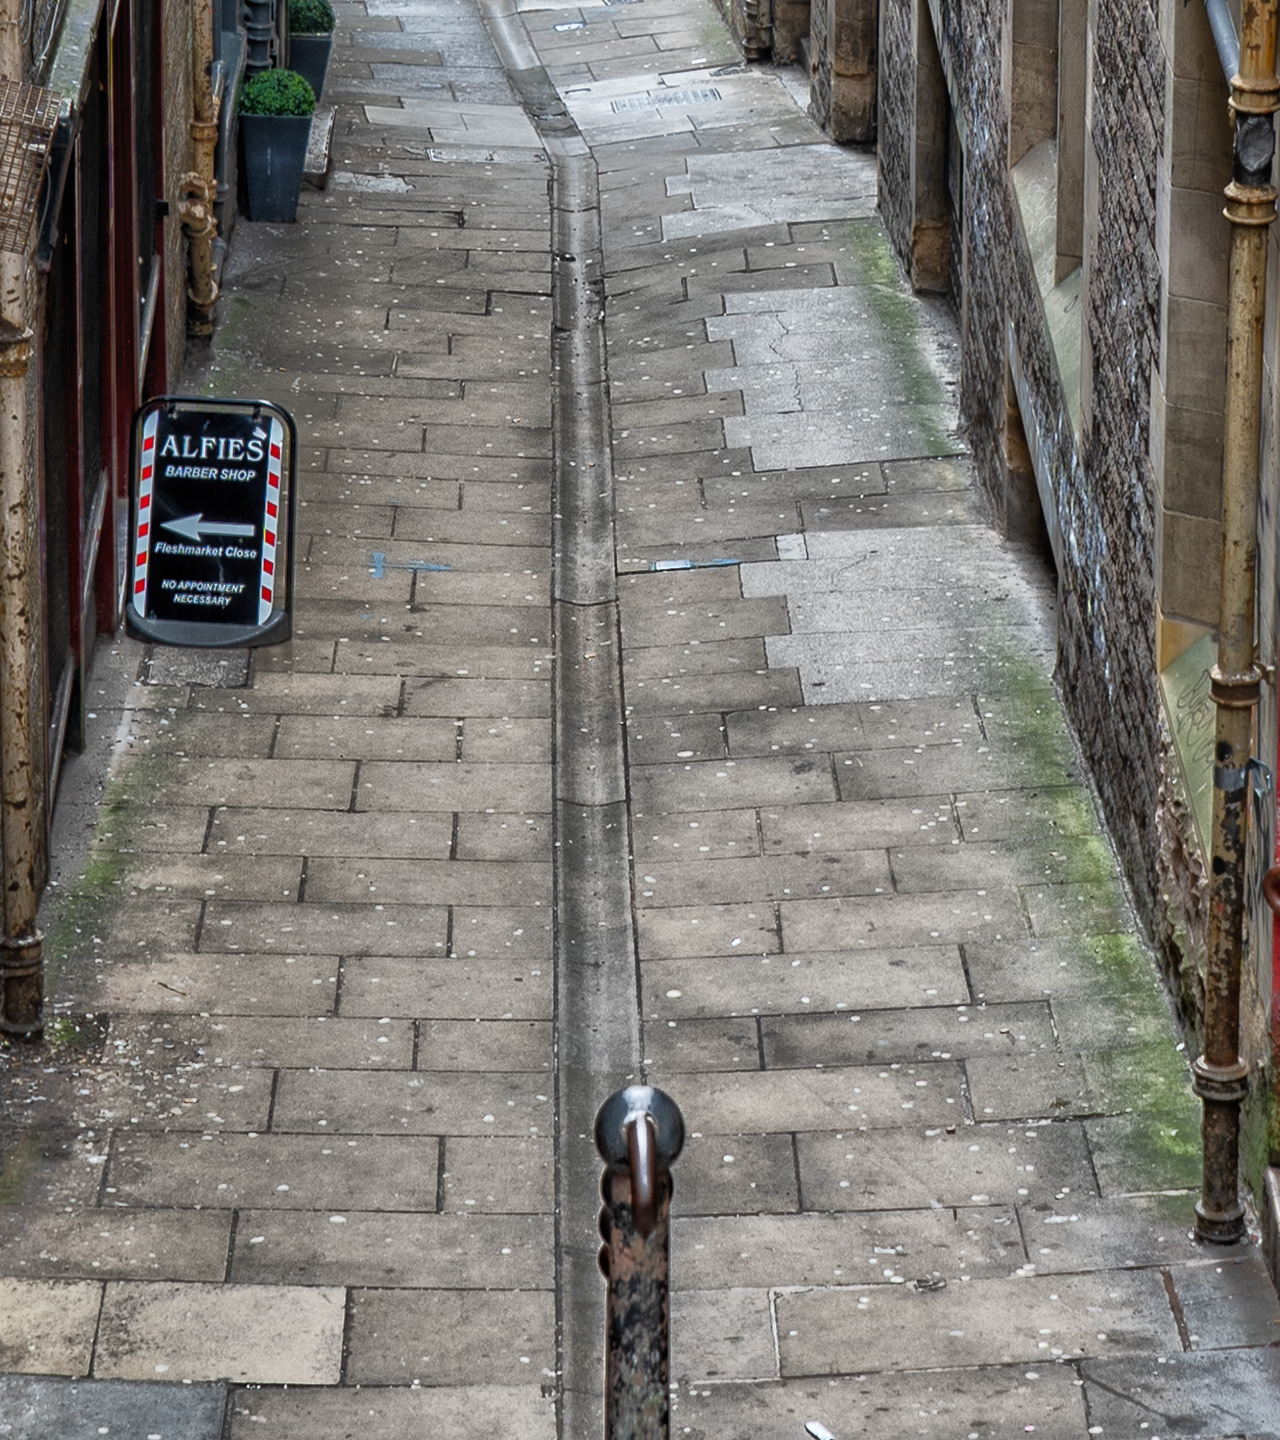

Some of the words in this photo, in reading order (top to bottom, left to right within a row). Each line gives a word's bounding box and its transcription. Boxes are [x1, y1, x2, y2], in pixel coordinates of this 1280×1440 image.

[159, 434, 265, 462] ALFIES
[165, 465, 218, 481] BARBER
[220, 468, 257, 483] SHOP
[154, 541, 223, 557] Fleshmarket
[225, 546, 258, 559] Close
[161, 579, 177, 590] NO
[177, 581, 246, 594] APPOINTMENT
[173, 593, 233, 607] NECESSARY
